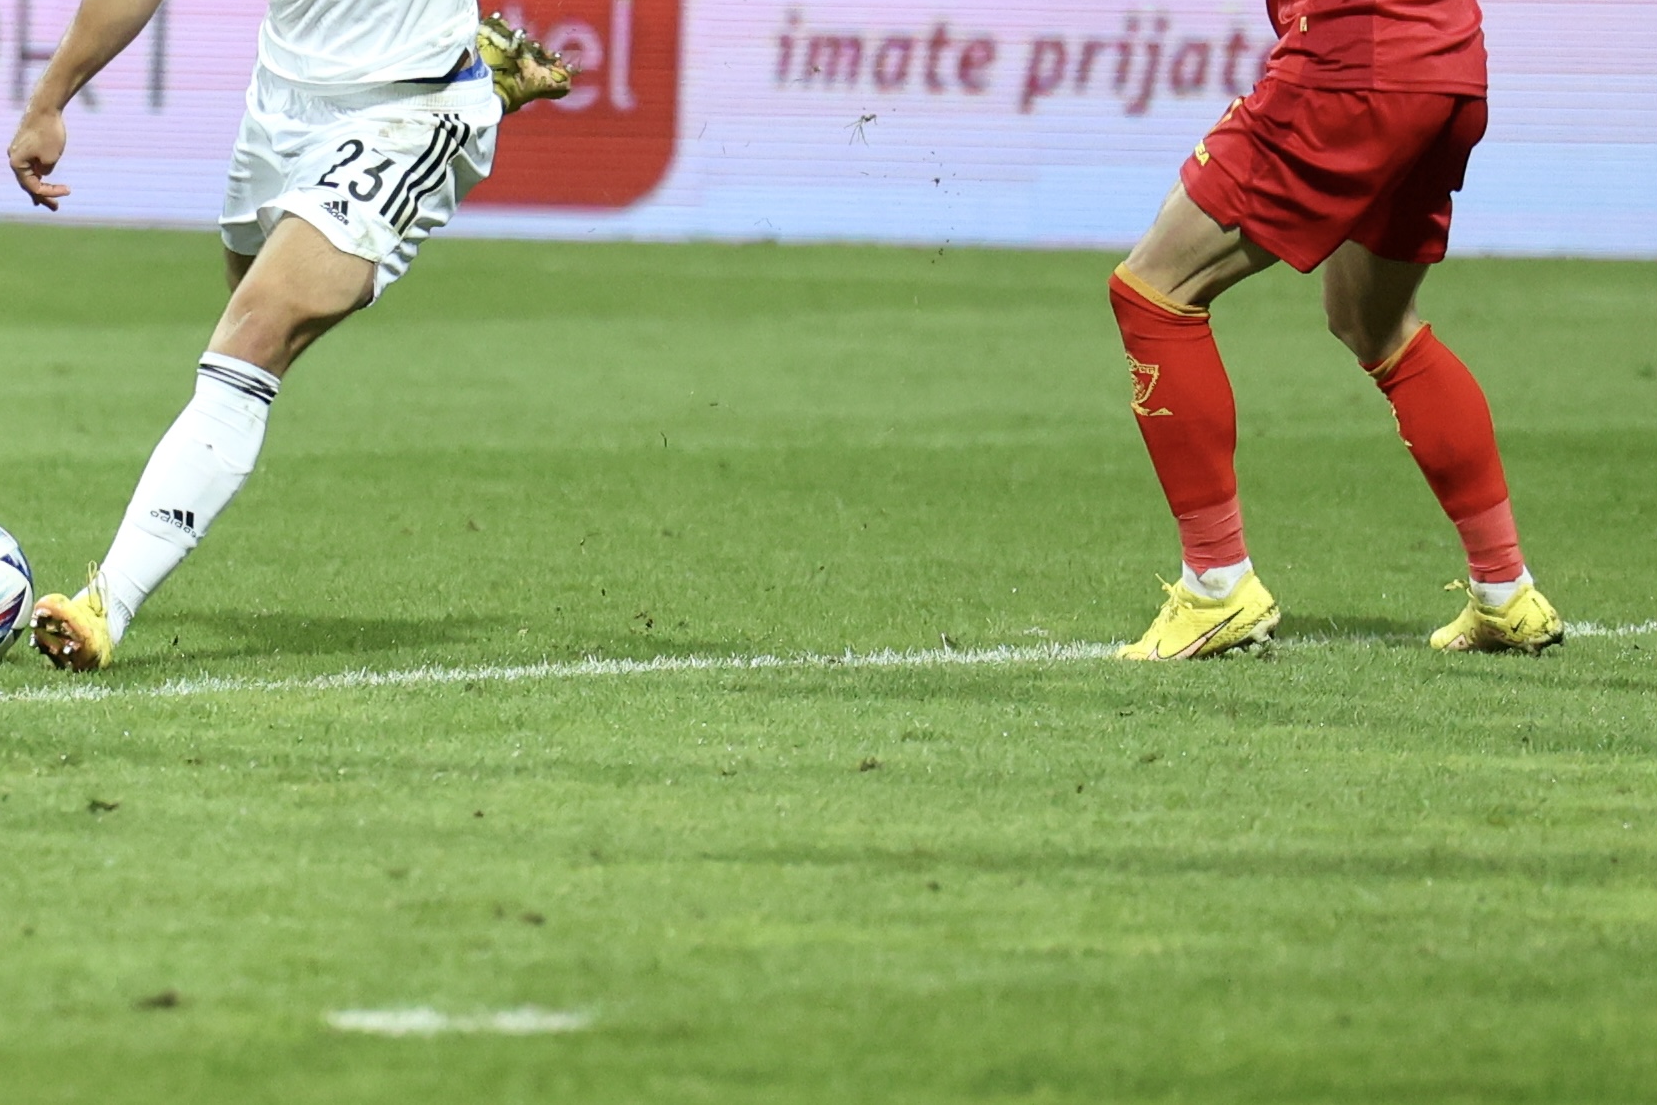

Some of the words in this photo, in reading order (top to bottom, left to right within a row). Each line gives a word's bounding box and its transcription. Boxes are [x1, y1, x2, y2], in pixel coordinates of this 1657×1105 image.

[776, 7, 997, 94] imate
[315, 138, 397, 203] 23
[149, 508, 198, 539] adidas
